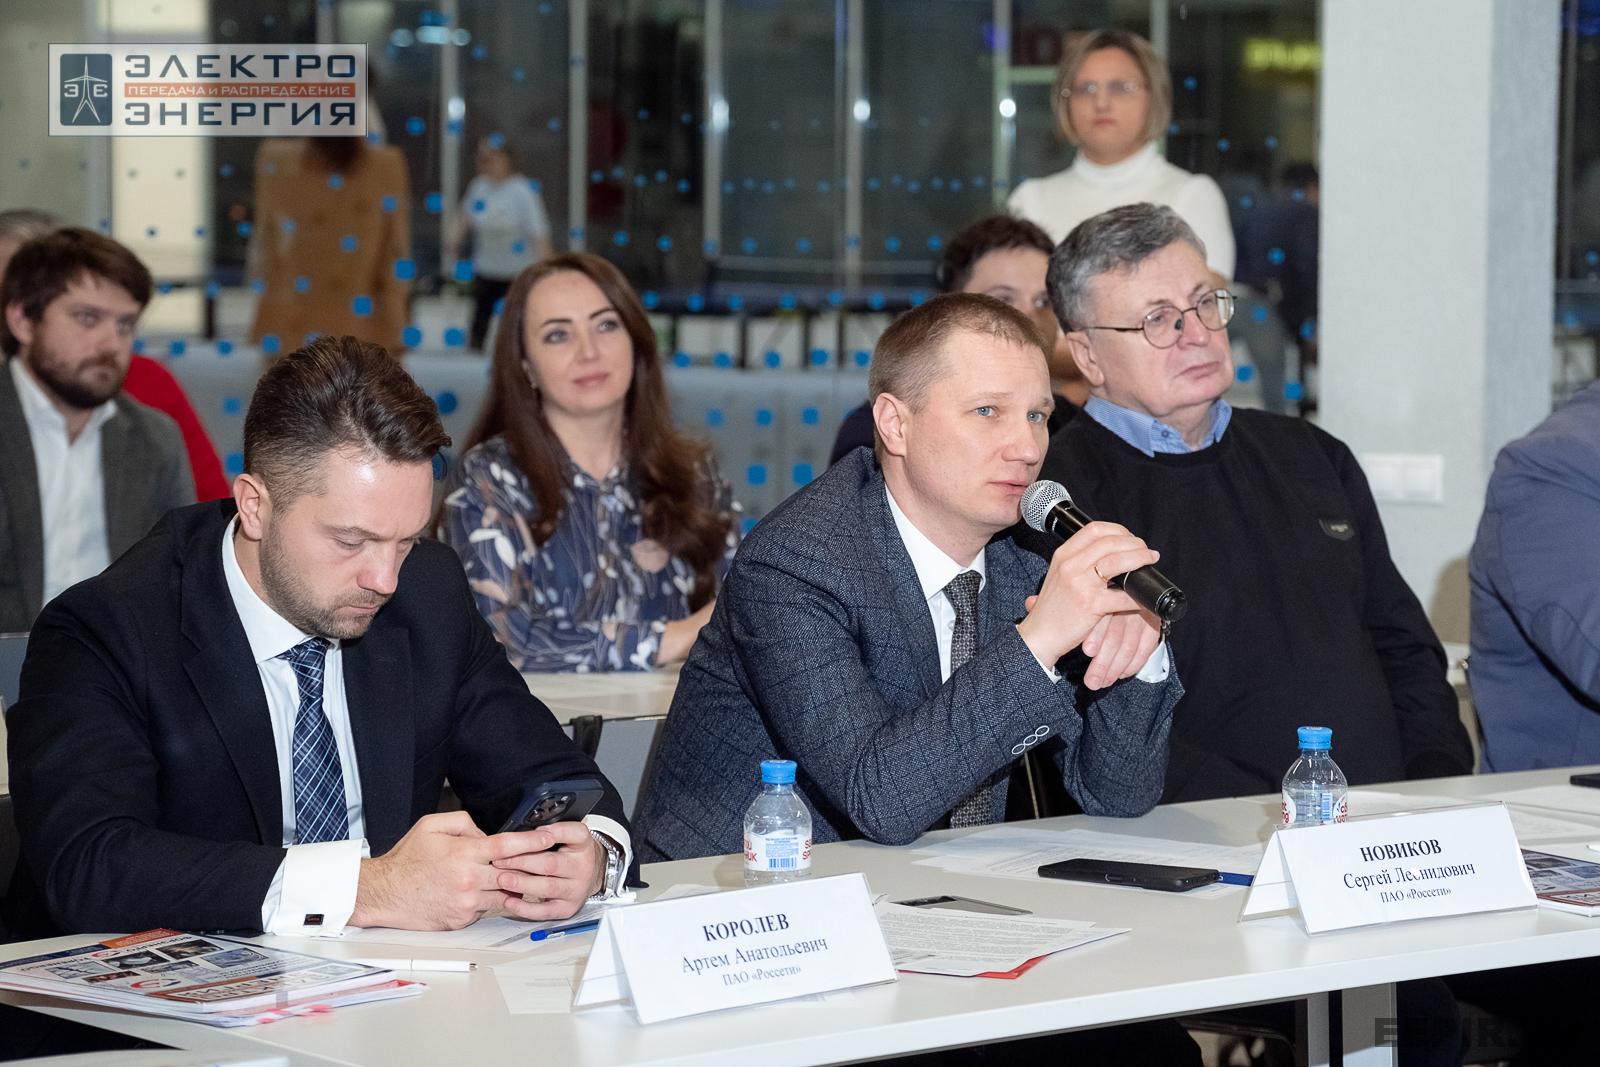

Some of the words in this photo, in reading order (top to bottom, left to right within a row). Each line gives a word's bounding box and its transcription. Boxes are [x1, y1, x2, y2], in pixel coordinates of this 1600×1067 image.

[1360, 839, 1442, 862] НОВИКОВ
[1343, 869, 1392, 891] Сергей
[1380, 889, 1405, 903] ПАО
[1406, 887, 1452, 899] «Россети»
[702, 913, 790, 942] КОРОЛЕВ
[682, 953, 731, 976] Артем
[735, 938, 828, 965] Анатольевич
[722, 970, 749, 986] ПАО
[752, 966, 802, 981] «Россети»
